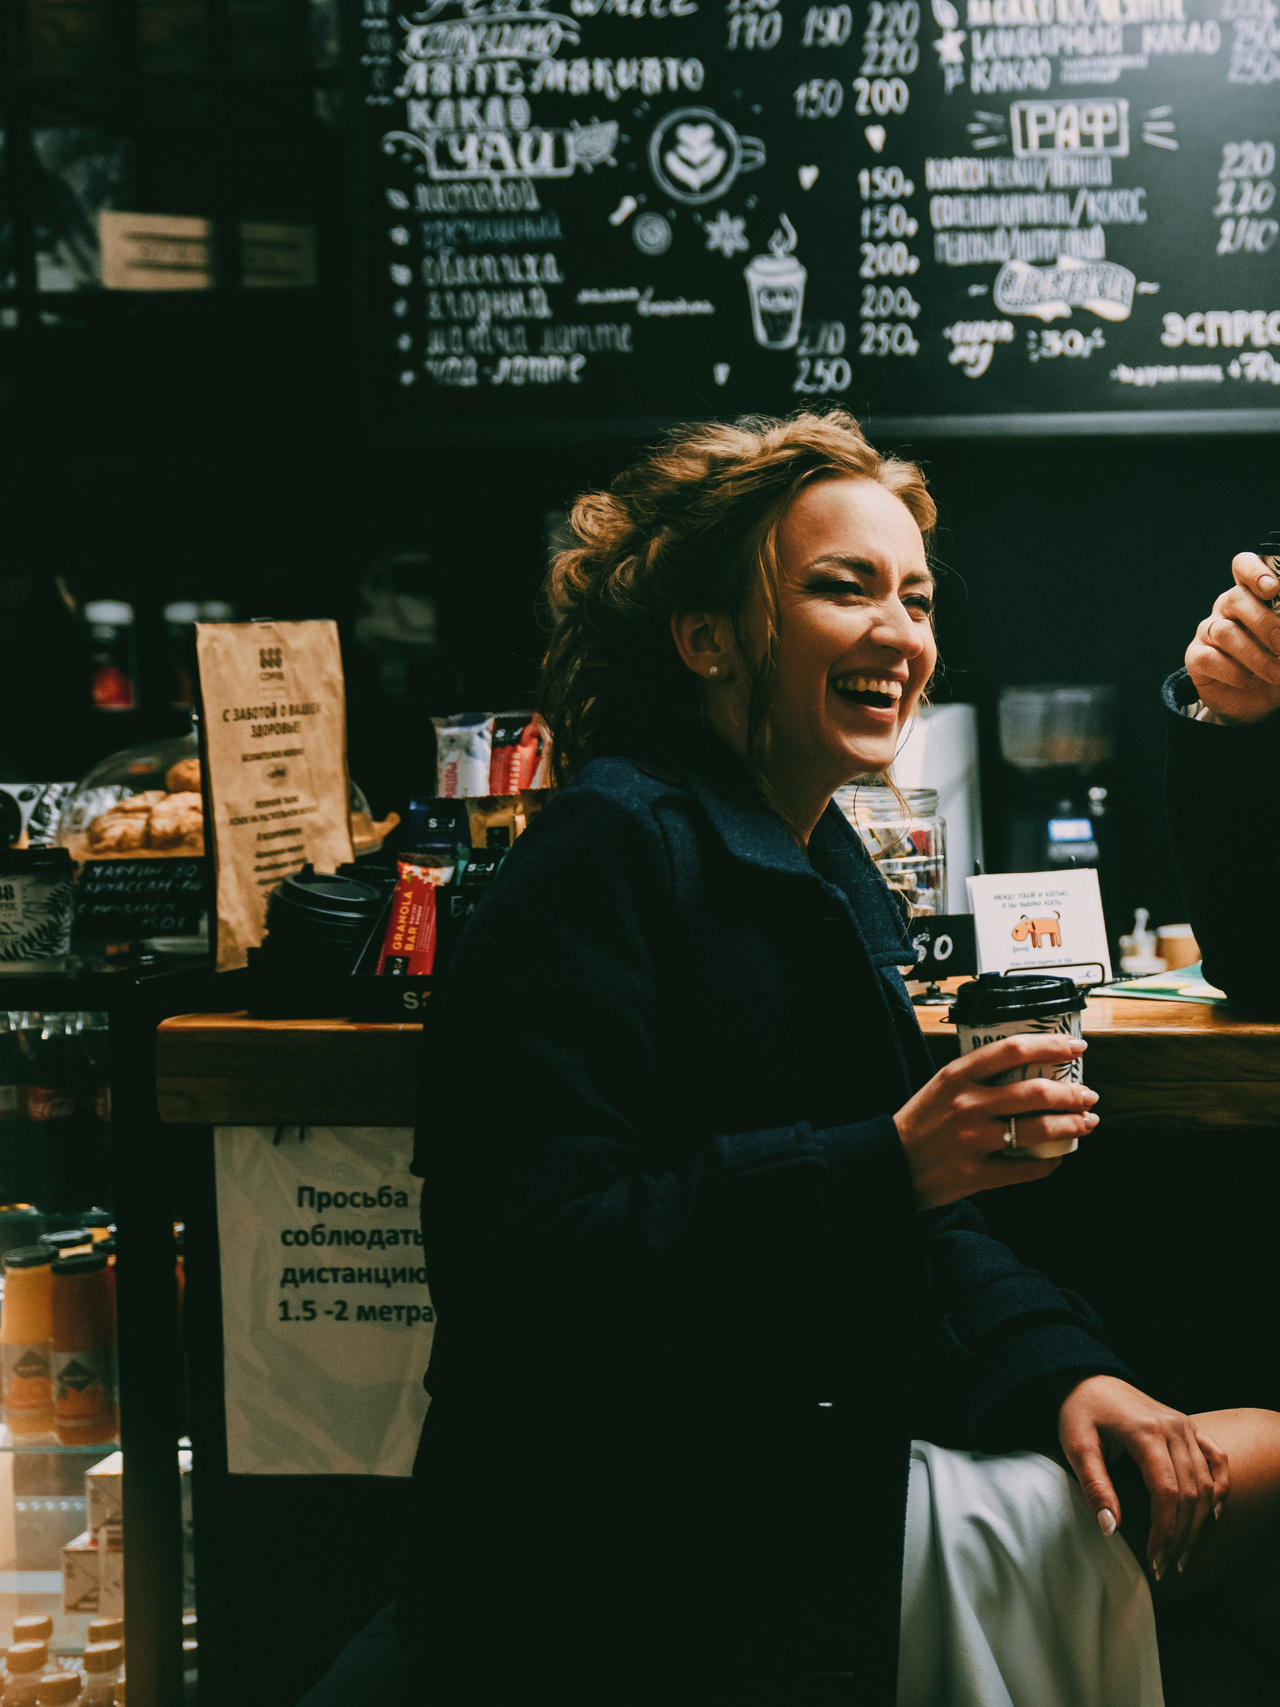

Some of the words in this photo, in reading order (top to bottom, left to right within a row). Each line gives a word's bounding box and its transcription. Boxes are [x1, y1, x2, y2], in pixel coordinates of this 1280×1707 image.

[1142, 19, 1222, 54] КАКАО
[970, 56, 1052, 94] КАКАО
[793, 77, 845, 119] 150
[852, 76, 910, 116] 200
[406, 97, 532, 134] КАКАО
[1024, 103, 1118, 149] РАФ
[792, 357, 852, 394] 250
[222, 708, 231, 723] С
[232, 701, 277, 722] ЗАБОТОЙ
[279, 704, 287, 717] О
[391, 889, 414, 951] GRANOLA
[403, 926, 418, 951] BAR
[297, 1185, 409, 1214] Просьба
[280, 1223, 425, 1251] соблюдать
[279, 1266, 428, 1289] дистанцию
[278, 1300, 318, 1322] 1.5
[355, 1304, 434, 1327] метра
